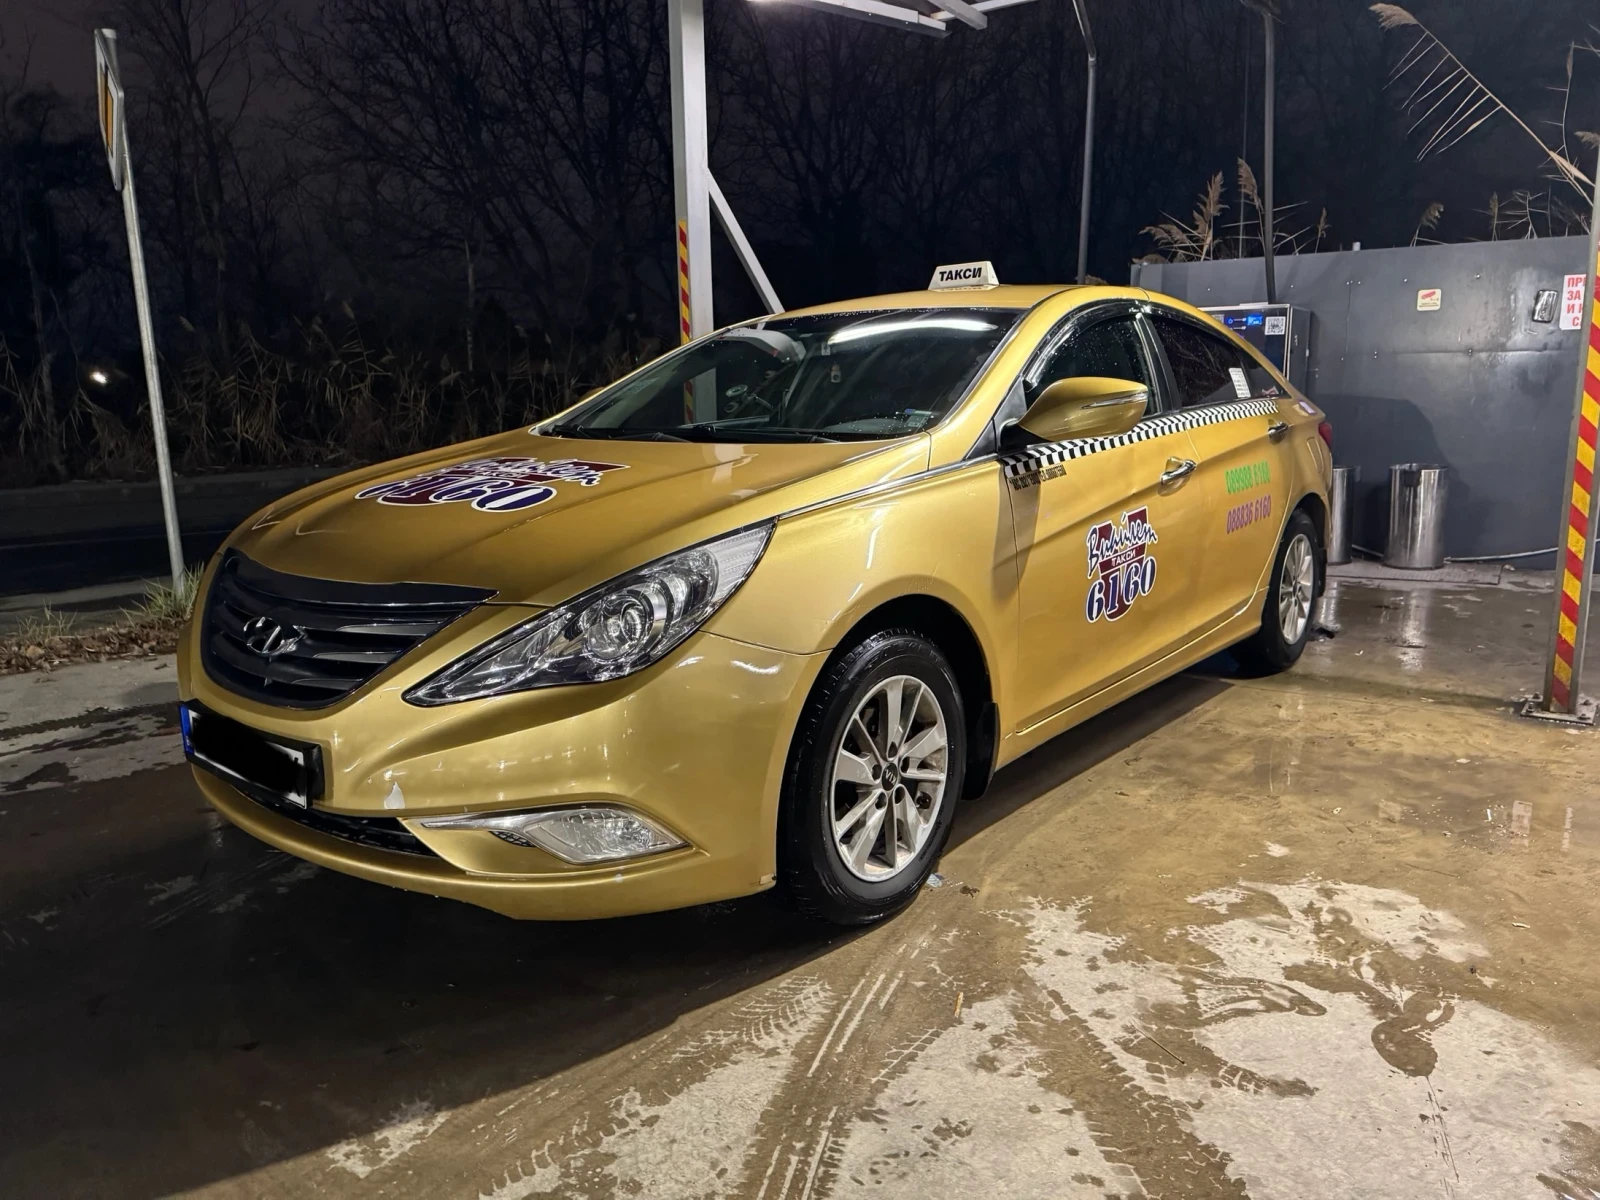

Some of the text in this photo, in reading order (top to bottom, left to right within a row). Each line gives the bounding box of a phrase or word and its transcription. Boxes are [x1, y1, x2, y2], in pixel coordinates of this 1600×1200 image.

[939, 267, 982, 281] ТАКСИ
[1567, 290, 1581, 301] ЗА
[1572, 316, 1581, 327] С
[1254, 494, 1272, 522] 6160
[1111, 549, 1136, 567] ТАКСИ
[1086, 556, 1157, 623] 6160
